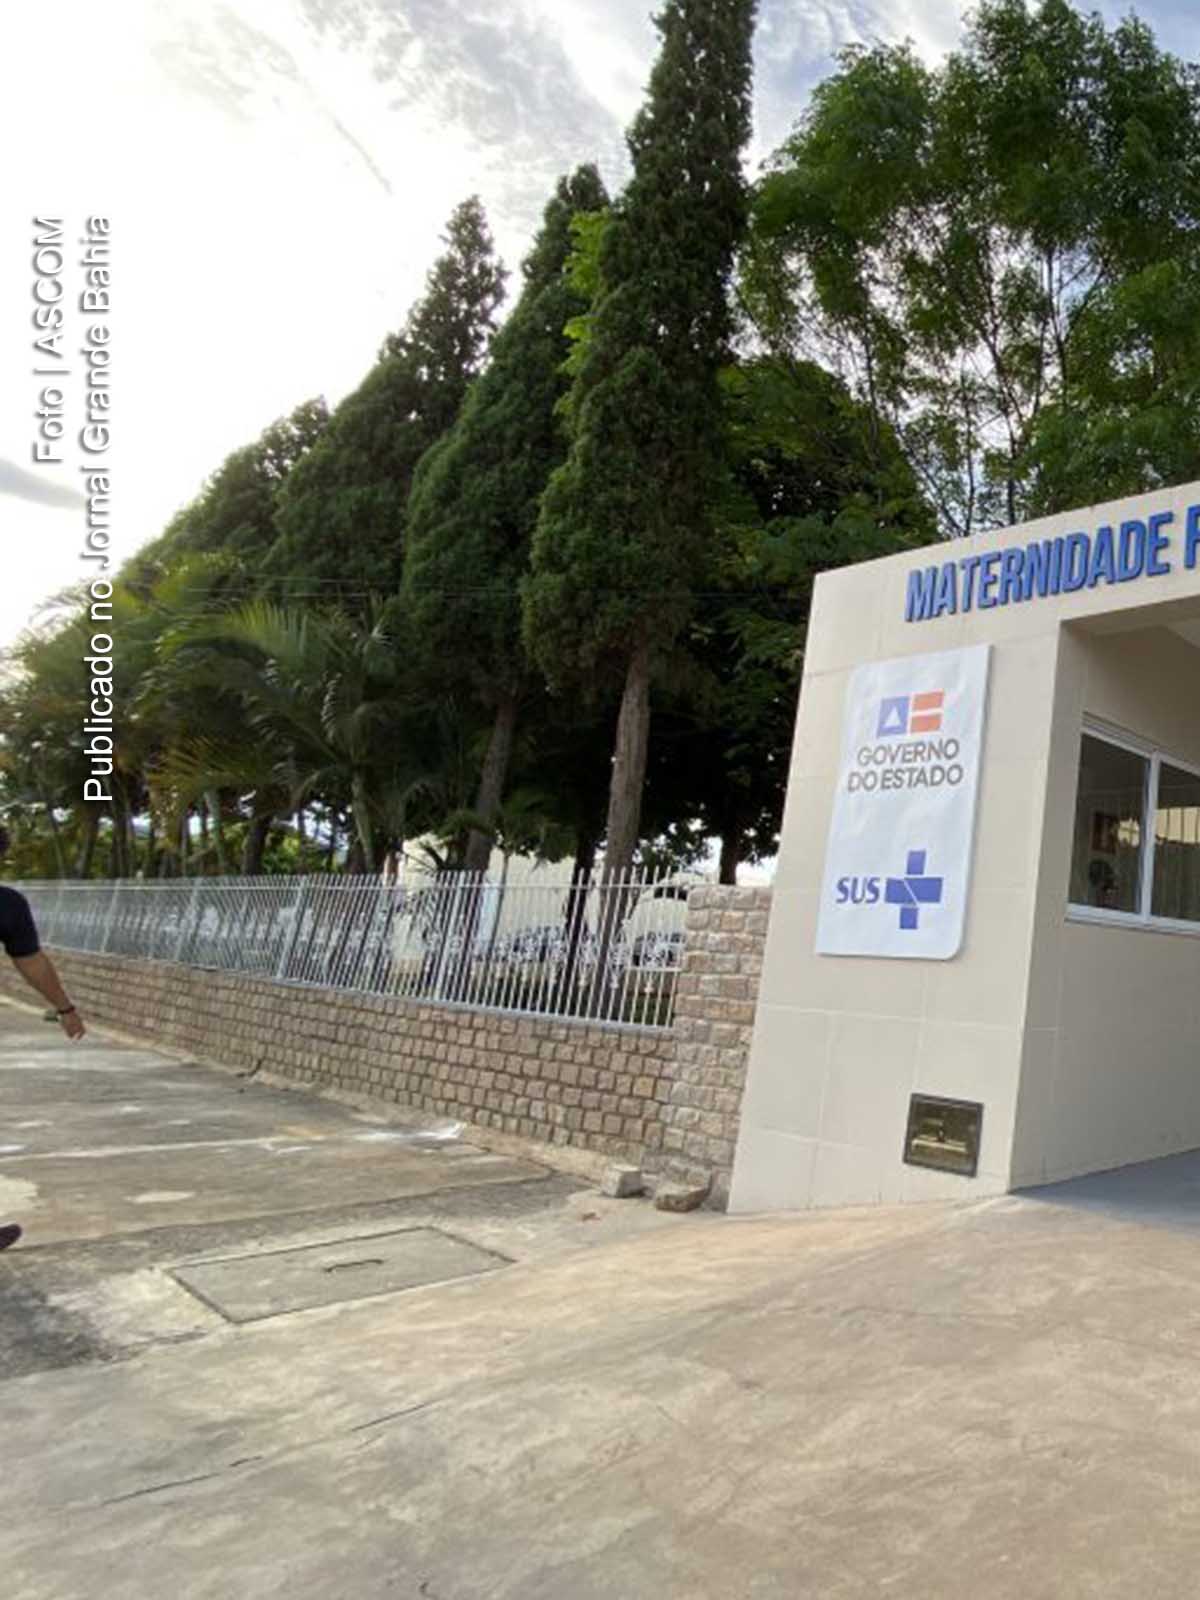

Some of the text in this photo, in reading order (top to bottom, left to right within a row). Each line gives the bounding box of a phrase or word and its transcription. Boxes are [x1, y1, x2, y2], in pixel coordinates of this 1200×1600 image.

[905, 511, 1174, 623] MATERNIDADE
[857, 738, 960, 767] GOVERNO
[848, 763, 964, 792] DO ESTADO
[835, 876, 880, 904] SUS
